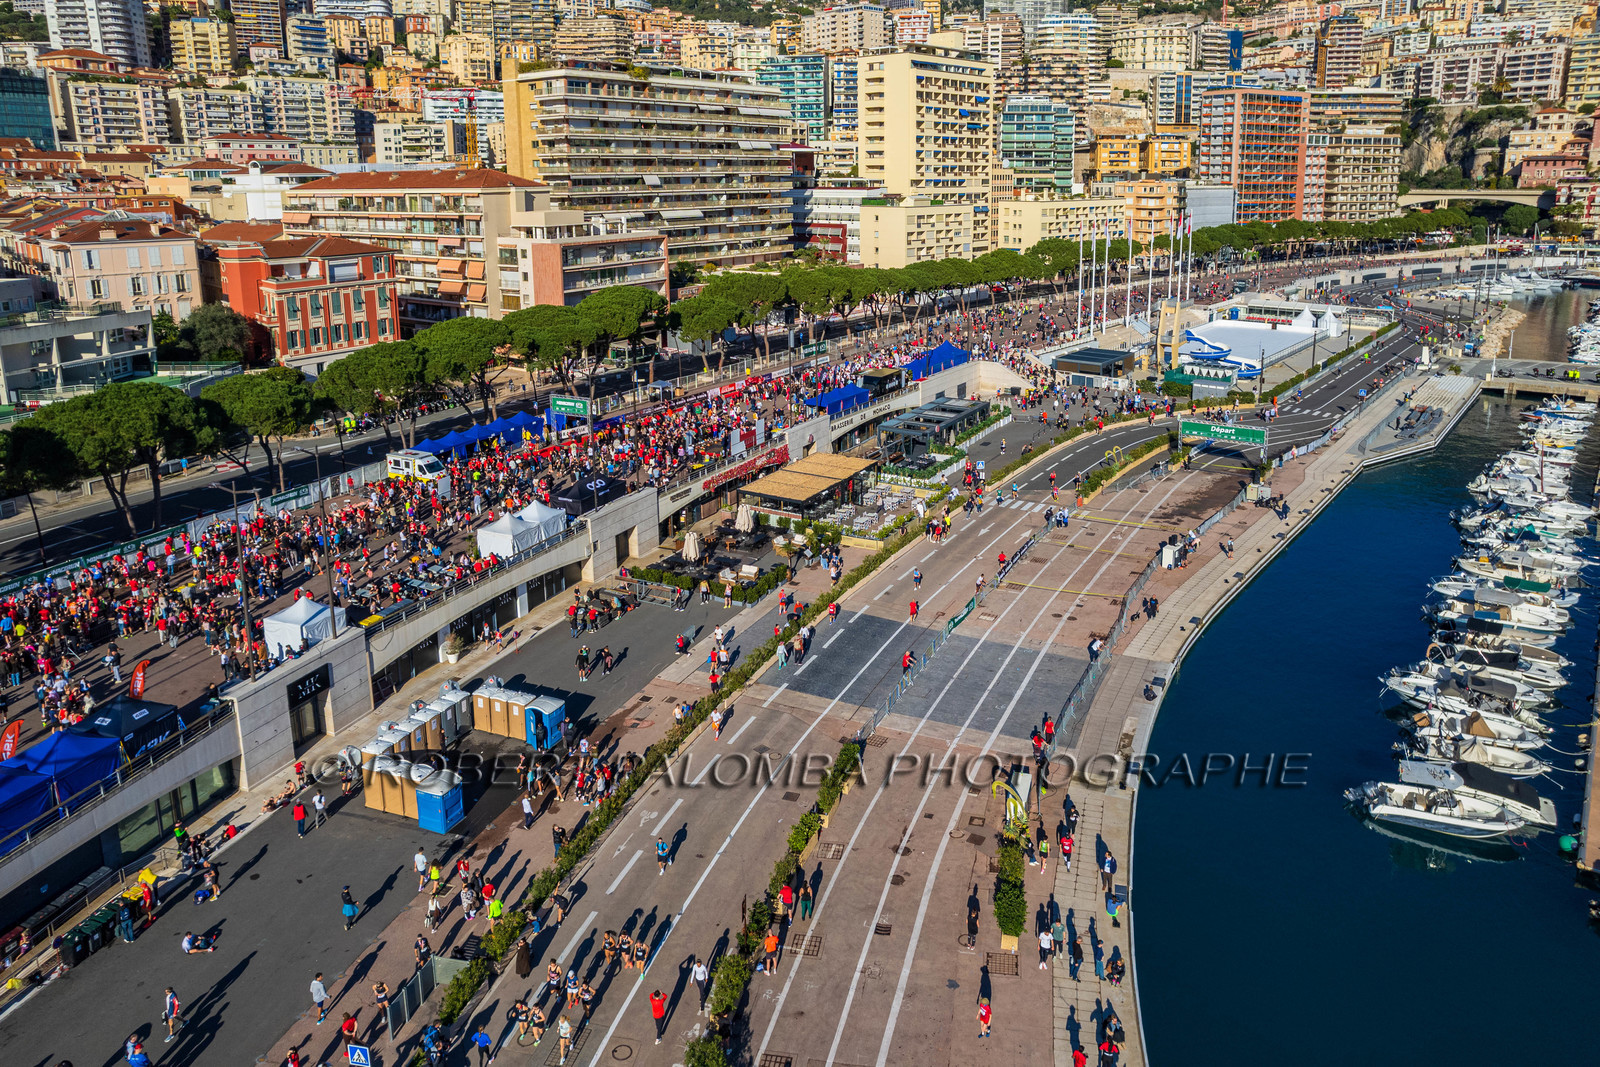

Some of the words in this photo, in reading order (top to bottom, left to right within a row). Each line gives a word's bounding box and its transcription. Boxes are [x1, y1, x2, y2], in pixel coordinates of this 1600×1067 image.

[831, 418, 854, 431] BRASSERIE
[873, 404, 891, 415] MONACO
[1210, 426, 1236, 434] Départ
